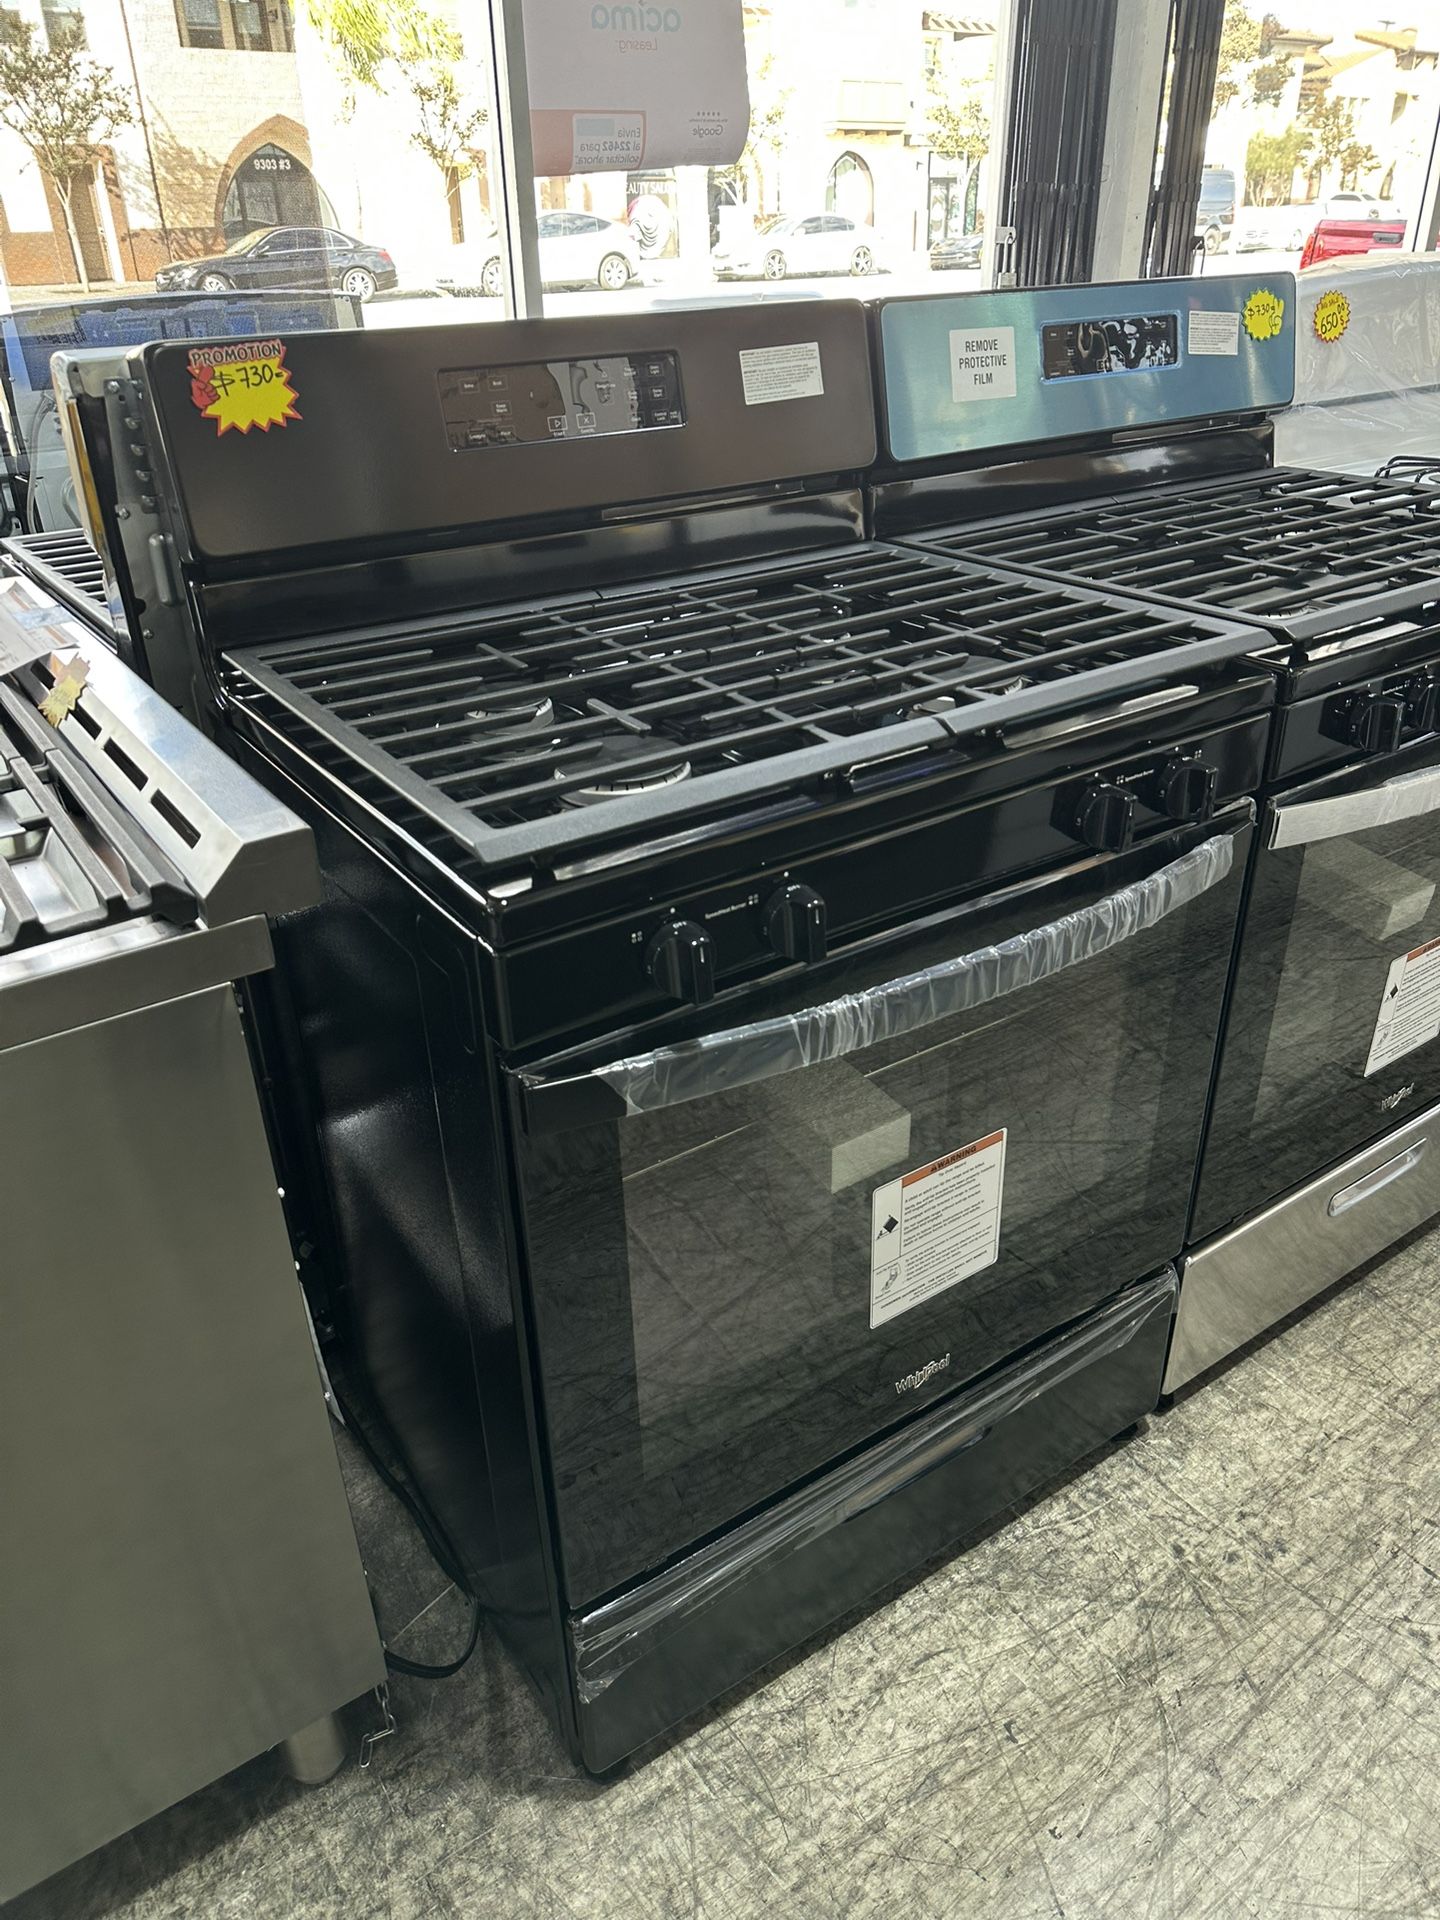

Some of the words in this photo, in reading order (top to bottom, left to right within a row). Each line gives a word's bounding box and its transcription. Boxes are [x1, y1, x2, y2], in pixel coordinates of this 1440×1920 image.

[253, 158, 277, 170] 9303
[278, 158, 291, 170] #3
[965, 339, 998, 353] REMOVE
[191, 342, 282, 367] PROMOTION
[959, 354, 1007, 370] PROTECTIVE
[973, 372, 993, 385] FILM
[935, 1145, 978, 1171] WARNING
[895, 1353, 951, 1394] Whirlpool
